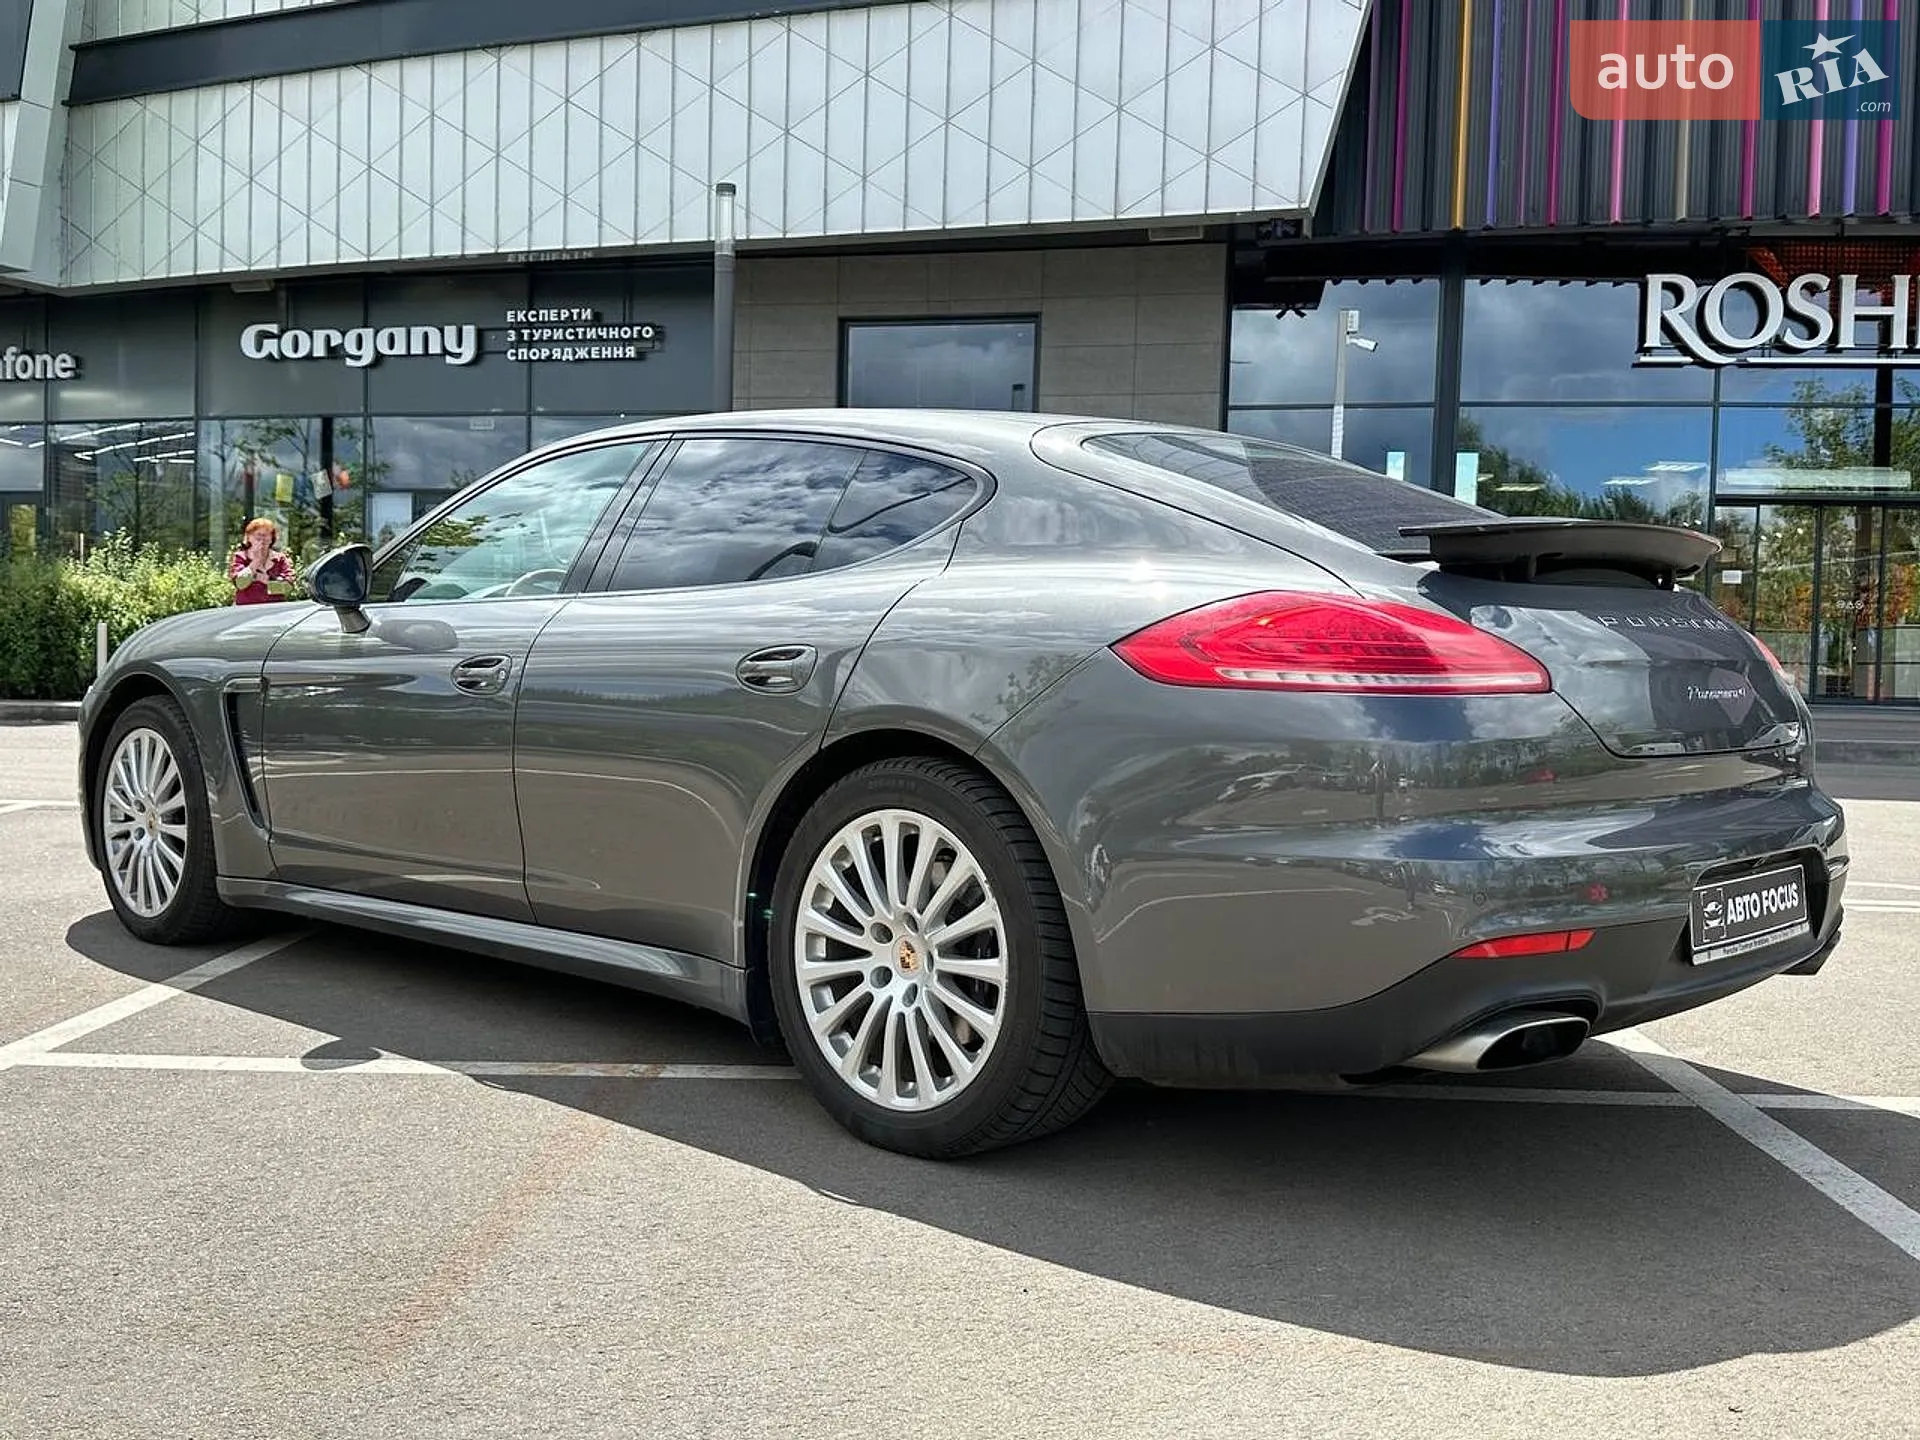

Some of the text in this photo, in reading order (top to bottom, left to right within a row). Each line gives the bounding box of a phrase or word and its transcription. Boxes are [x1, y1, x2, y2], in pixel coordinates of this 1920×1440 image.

[506, 308, 593, 323] ЕКСПЕРТИ
[1643, 272, 1920, 365] ROSH
[240, 323, 477, 368] Gorgany
[521, 325, 656, 342] ТУРИСТИЧНОГО
[0, 346, 77, 380] fone
[506, 346, 637, 362] СПОРЯДЖЕННЯ
[1761, 881, 1799, 915] FOCUS
